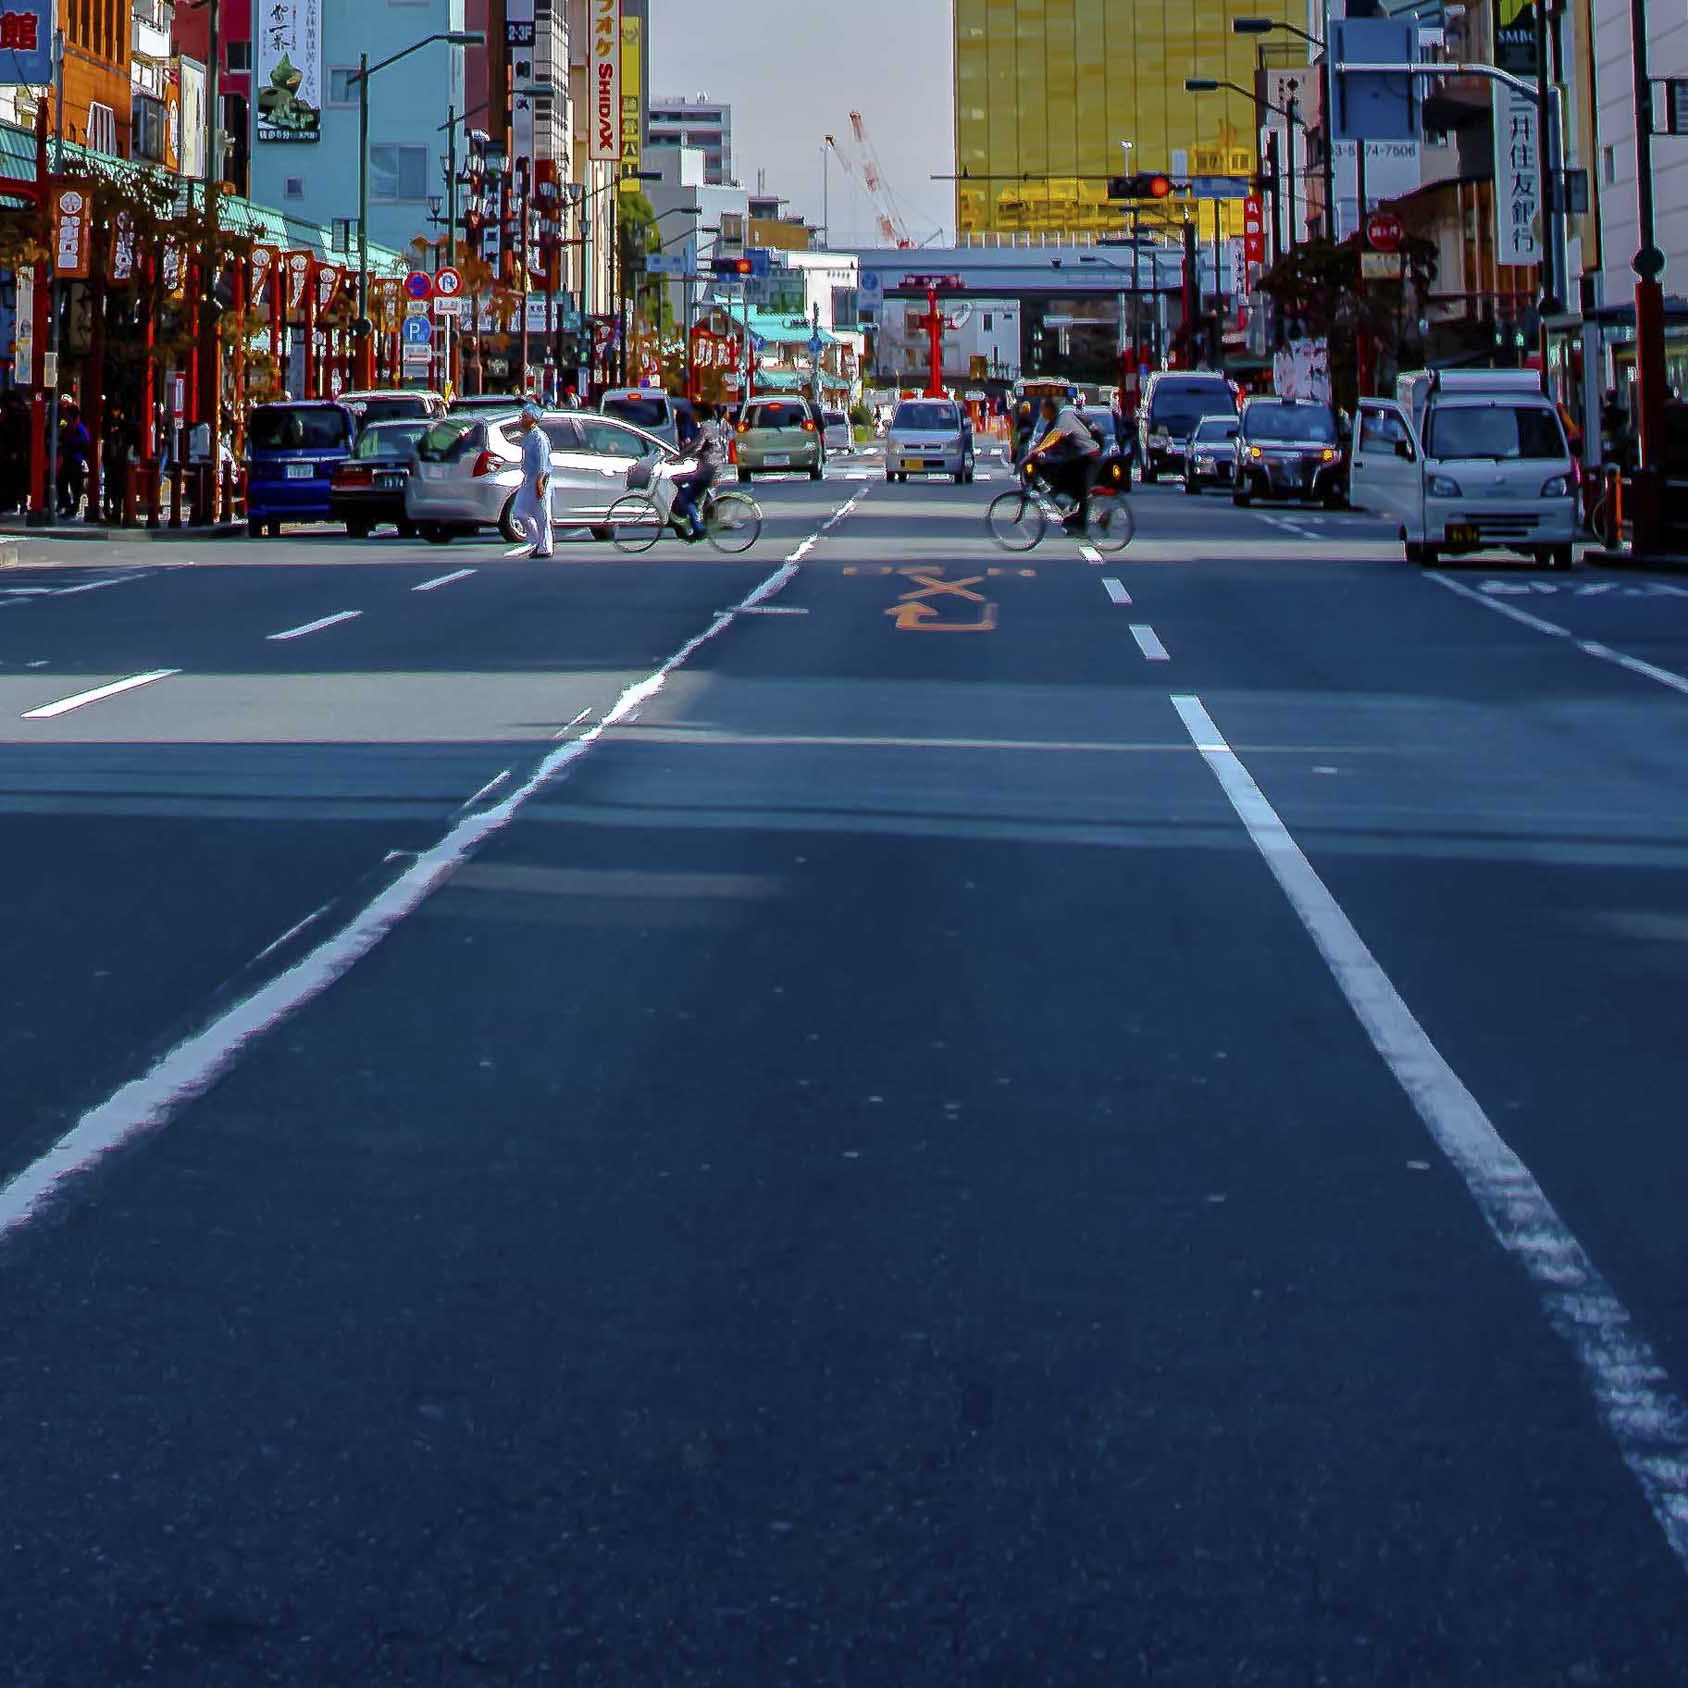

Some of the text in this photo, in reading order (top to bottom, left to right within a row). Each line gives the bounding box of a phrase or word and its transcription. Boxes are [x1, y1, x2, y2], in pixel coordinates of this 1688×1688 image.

[598, 63, 614, 152] SHIDAX
[1508, 88, 1535, 254] 三井住友銀行
[409, 322, 420, 340] P
